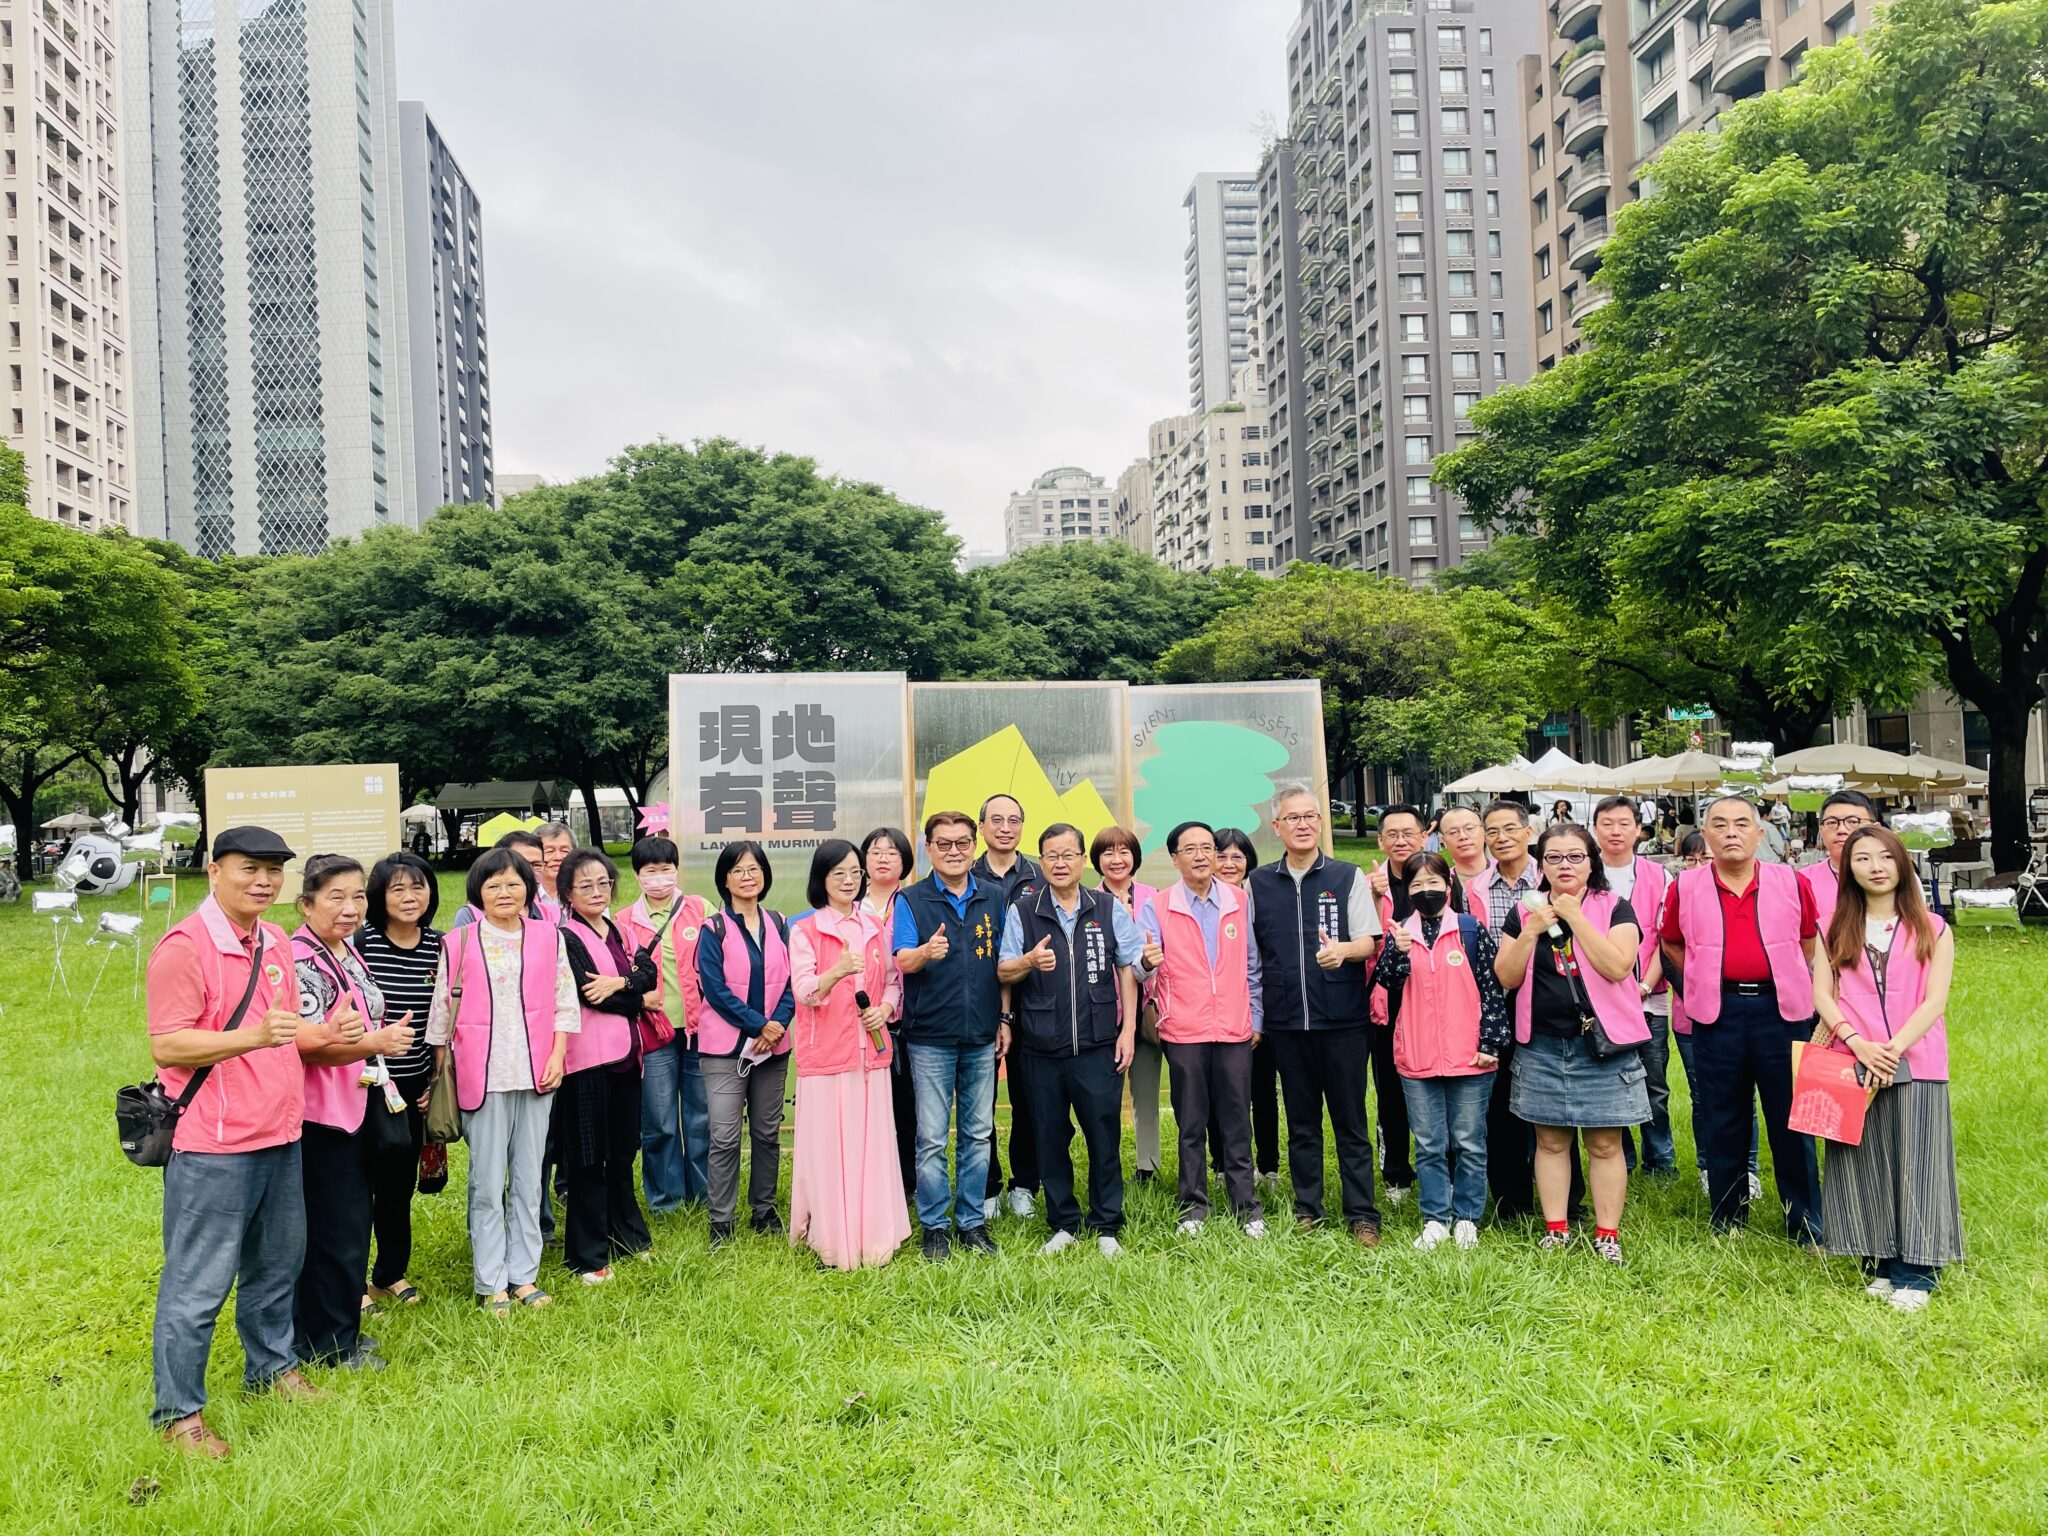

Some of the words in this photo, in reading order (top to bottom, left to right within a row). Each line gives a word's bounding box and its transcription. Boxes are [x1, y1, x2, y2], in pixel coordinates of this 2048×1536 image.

[700, 704, 836, 765] 現地
[1134, 707, 1176, 747] SILENT
[1248, 710, 1298, 746] ASSETS
[700, 771, 836, 834] 有聲
